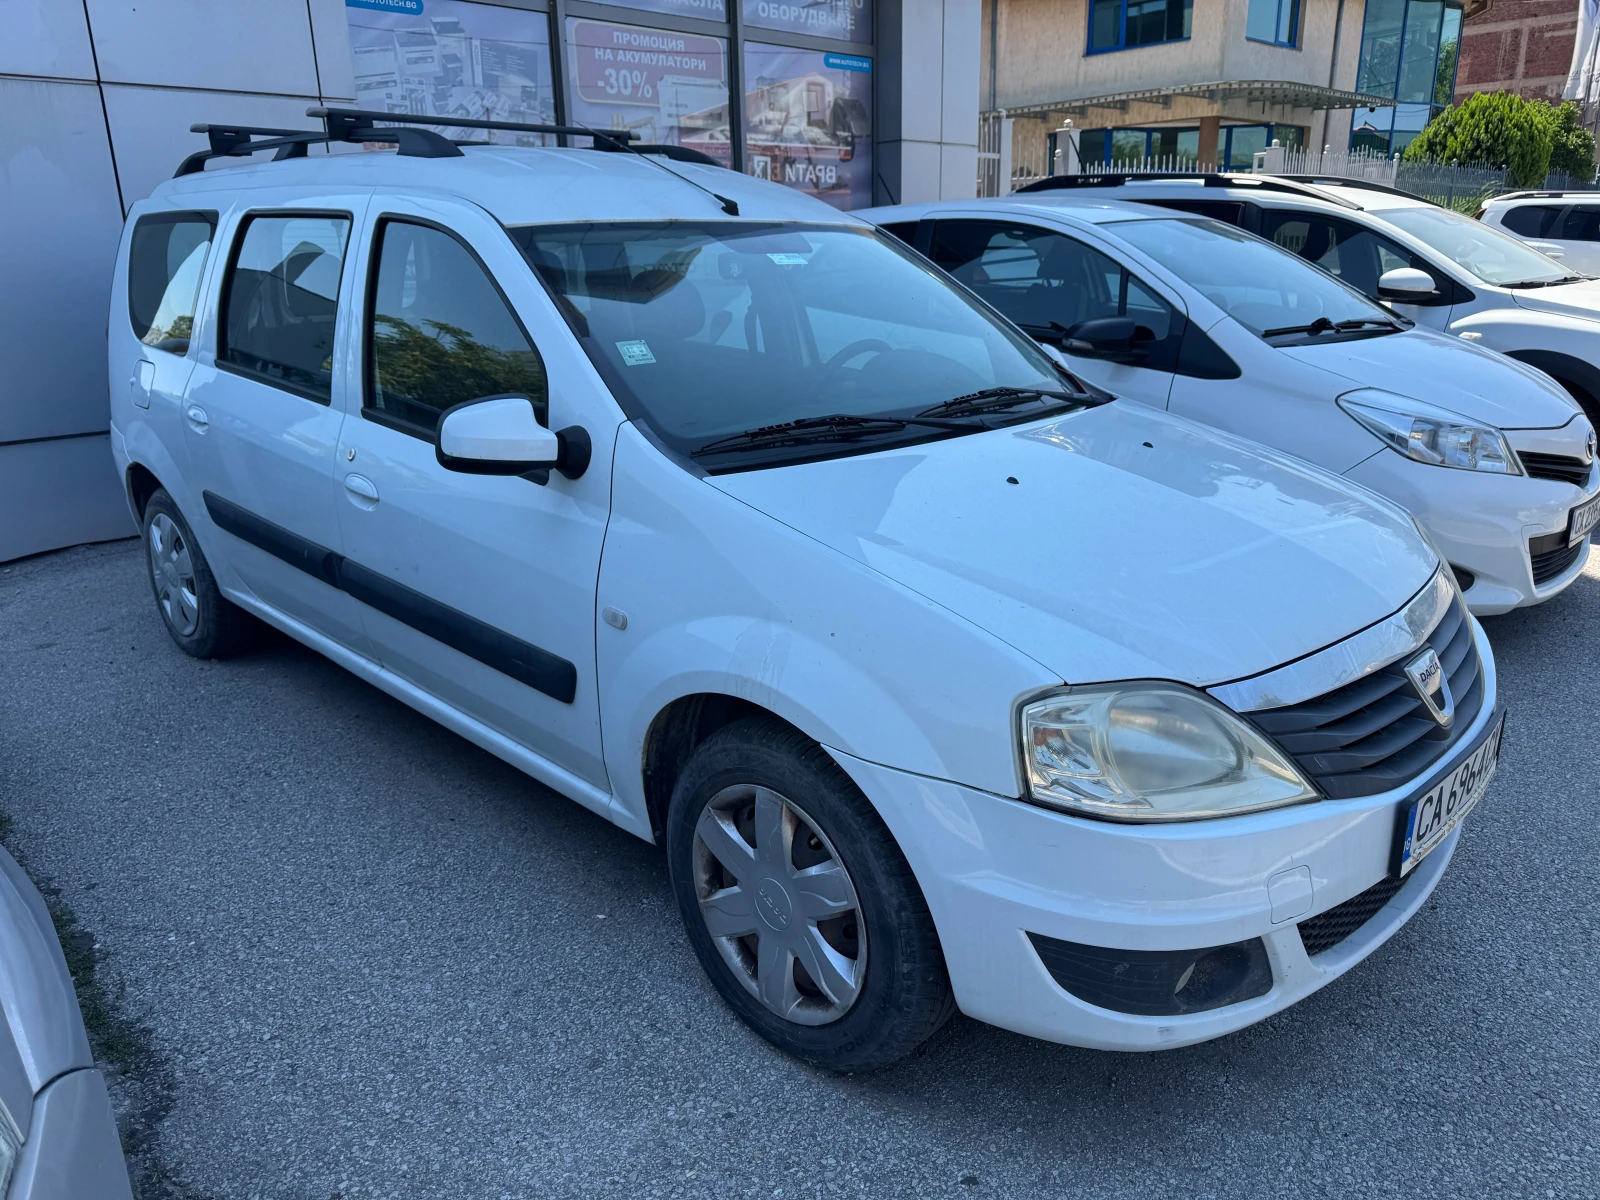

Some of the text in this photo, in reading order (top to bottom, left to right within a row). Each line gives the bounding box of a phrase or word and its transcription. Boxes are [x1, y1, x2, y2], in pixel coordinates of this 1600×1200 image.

[613, 31, 685, 52] ПРОМОЦИЯ
[594, 48, 707, 71] НА АКУМУЛАТОРИ
[597, 68, 652, 98] -30%
[1419, 661, 1440, 683] DACIA
